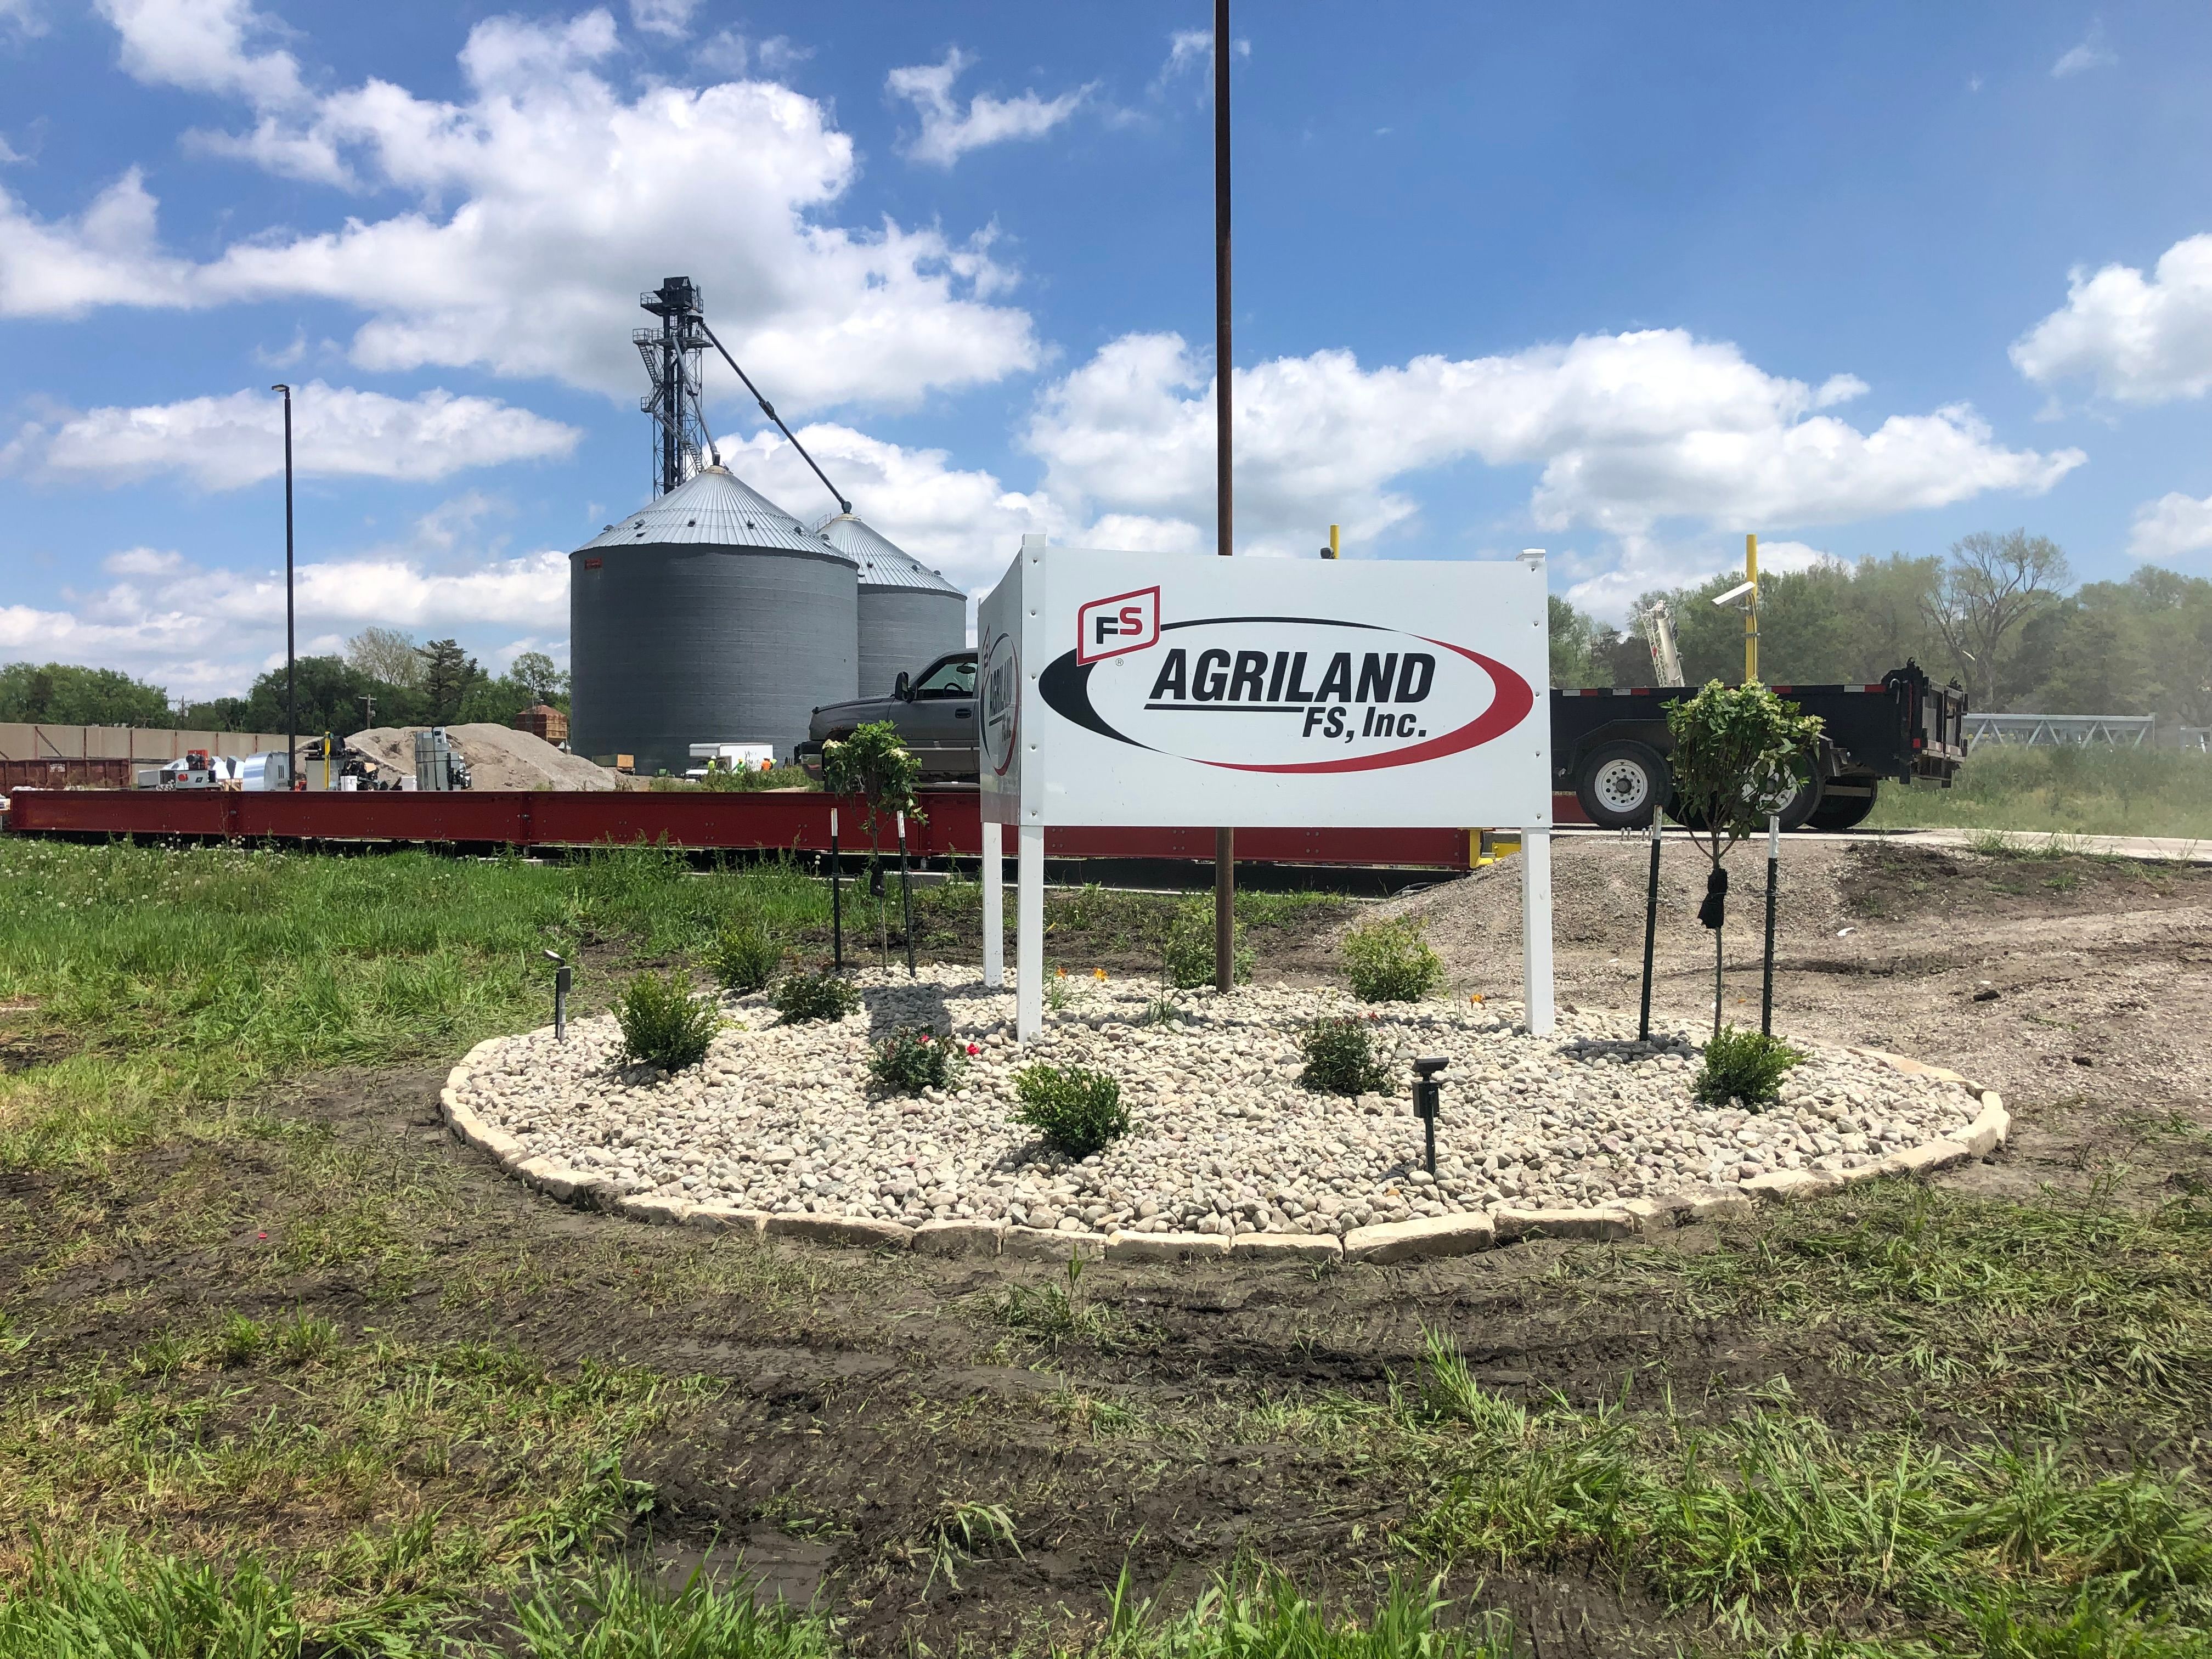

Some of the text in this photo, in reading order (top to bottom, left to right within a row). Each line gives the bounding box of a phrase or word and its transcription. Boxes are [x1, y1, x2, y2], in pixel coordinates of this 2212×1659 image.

[1096, 607, 1143, 644] FS
[1149, 648, 1436, 703] AGRILAND
[1302, 706, 1426, 743] FS, Inc.
